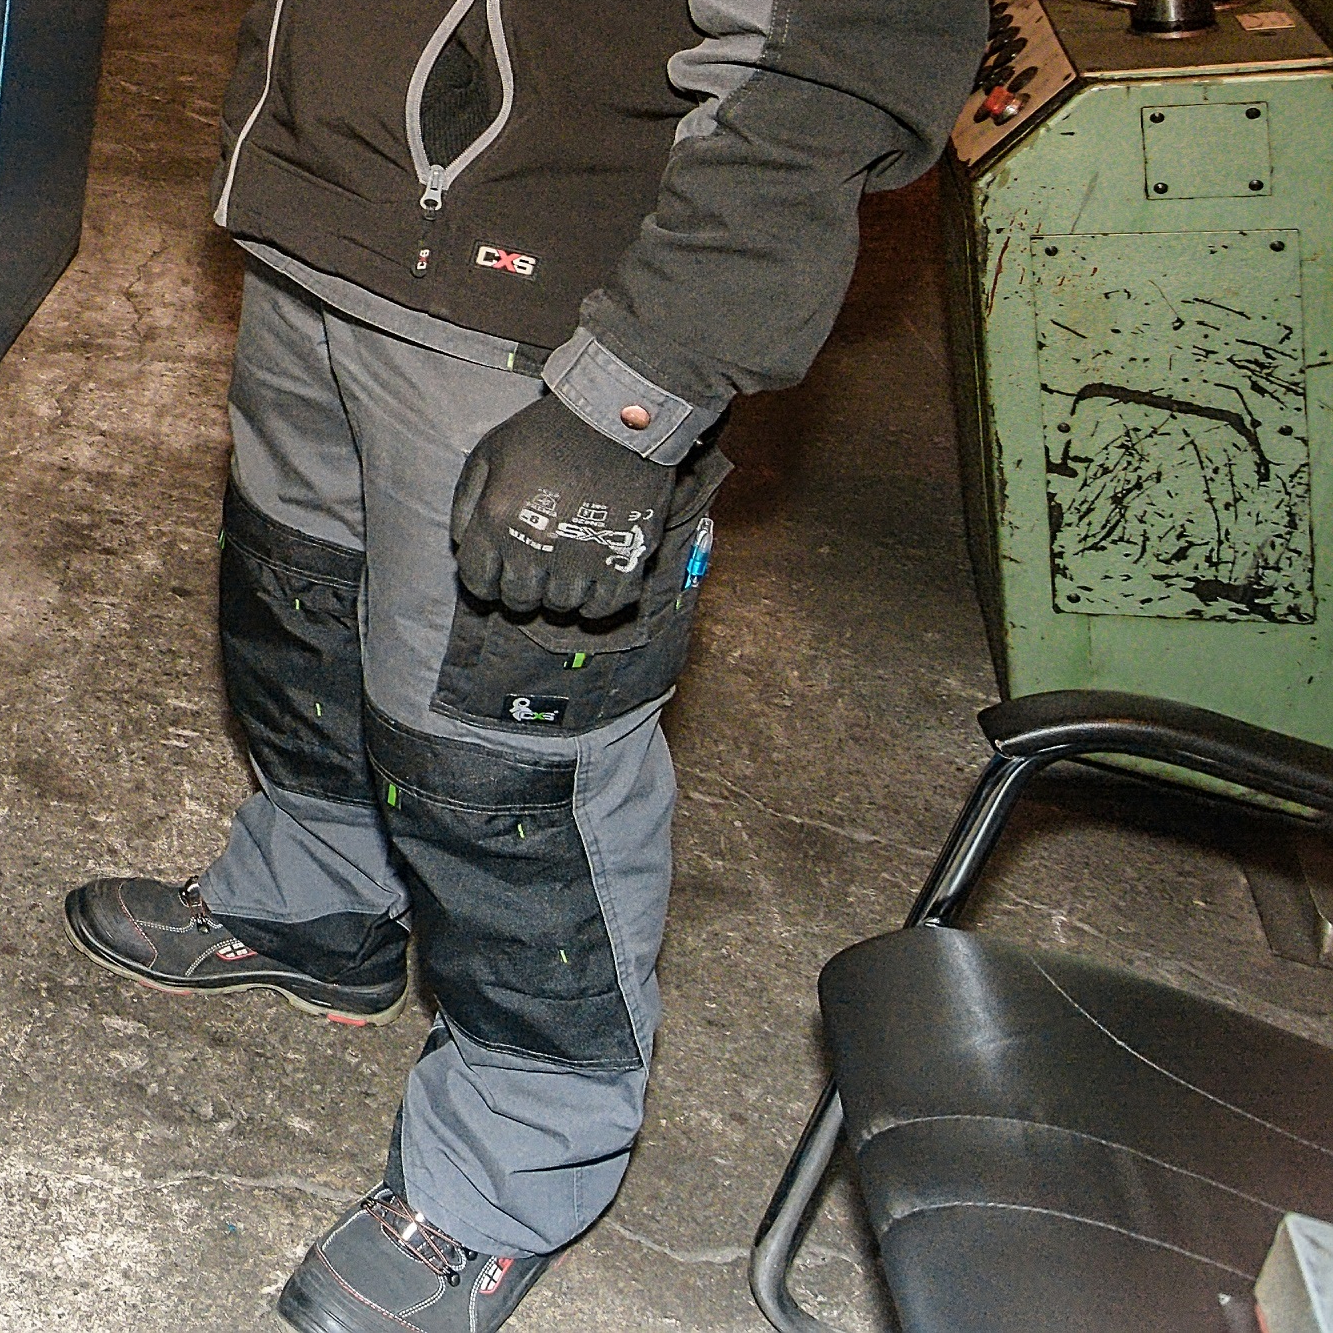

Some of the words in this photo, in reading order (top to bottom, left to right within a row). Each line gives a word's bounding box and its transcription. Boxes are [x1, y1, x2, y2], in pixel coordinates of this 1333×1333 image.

[416, 249, 431, 270] CXS
[476, 246, 536, 275] CXS
[555, 522, 634, 547] CXS
[520, 712, 555, 721] CXS
